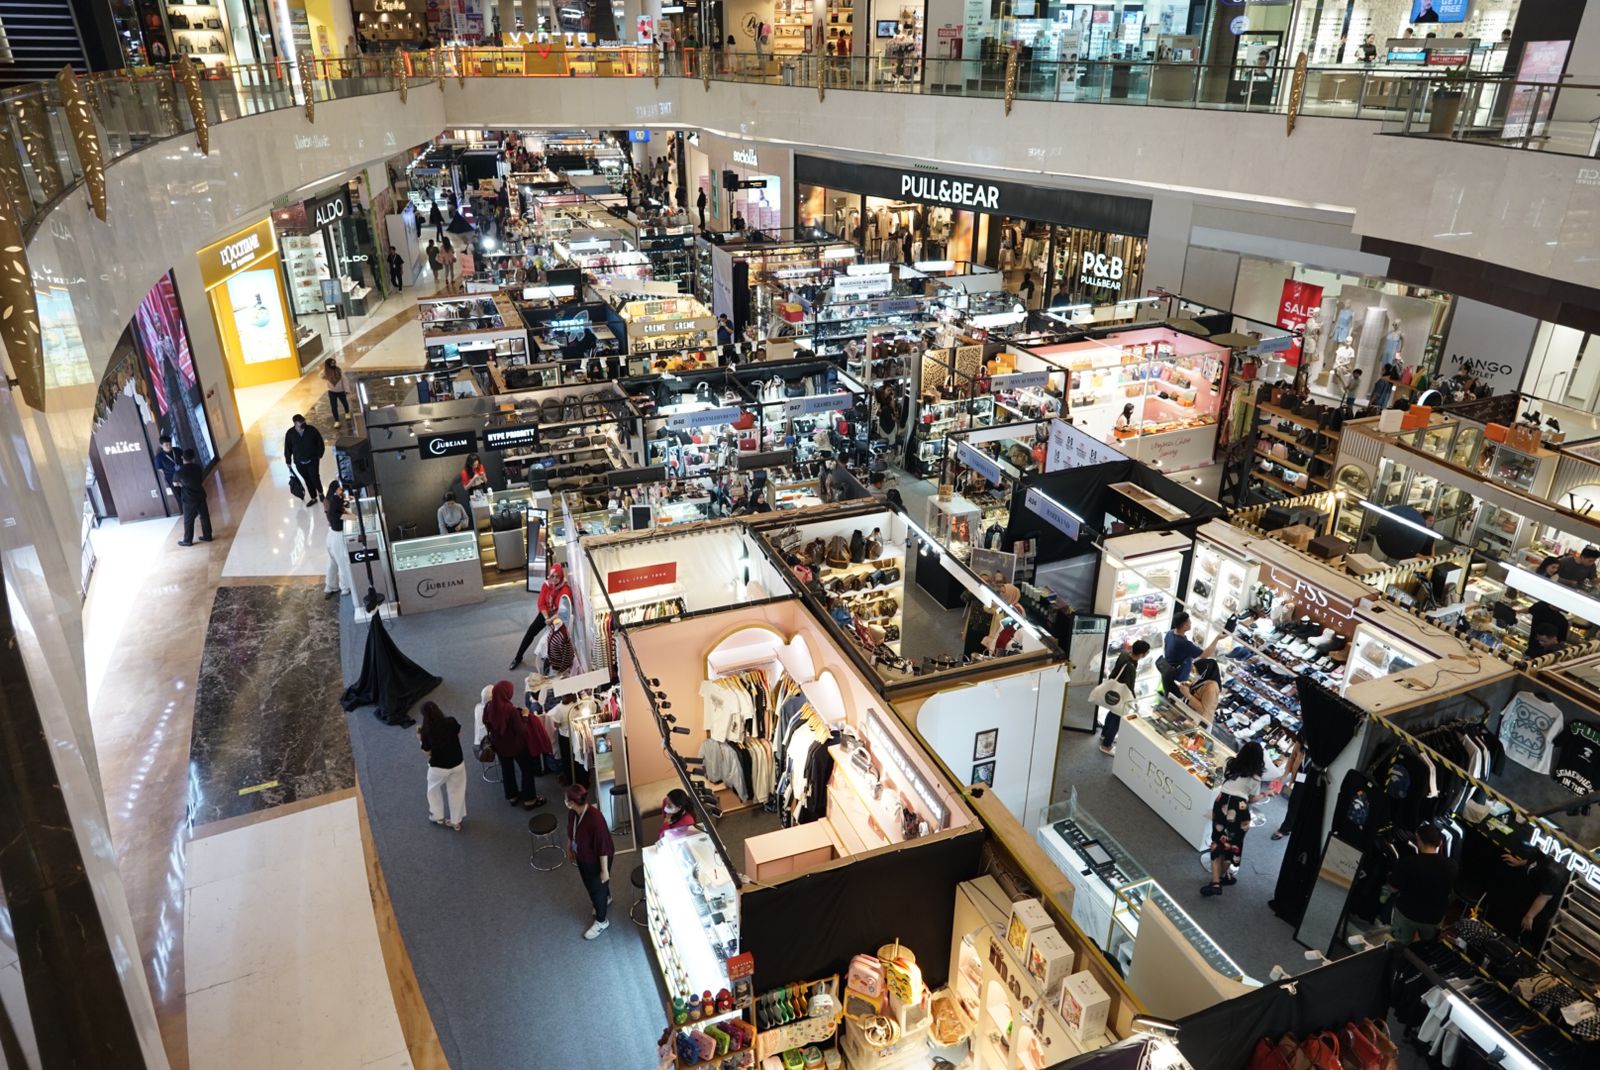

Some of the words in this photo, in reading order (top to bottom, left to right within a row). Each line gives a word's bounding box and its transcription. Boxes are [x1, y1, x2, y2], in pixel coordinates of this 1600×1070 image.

[733, 149, 758, 166] sociolla
[901, 175, 999, 209] PULL&BEAR
[316, 198, 344, 227] ALDO
[340, 255, 369, 263] ALDO
[1083, 251, 1124, 279] P&B
[1080, 275, 1121, 291] PULL&BEAR
[1284, 302, 1315, 317] SALE
[1451, 354, 1513, 375] MANGO
[1470, 369, 1494, 379] UTLET
[488, 433, 505, 441] HYPE
[506, 428, 535, 439] PRIORITY
[104, 443, 141, 455] PALACE
[433, 440, 467, 452] JUBEJAM
[420, 579, 464, 594] JUBEJAM
[1294, 580, 1327, 607] FSS
[1147, 761, 1174, 794] FSS
[1562, 777, 1571, 786] IN
[1571, 783, 1586, 796] THE
[1530, 828, 1600, 891] HYPE
